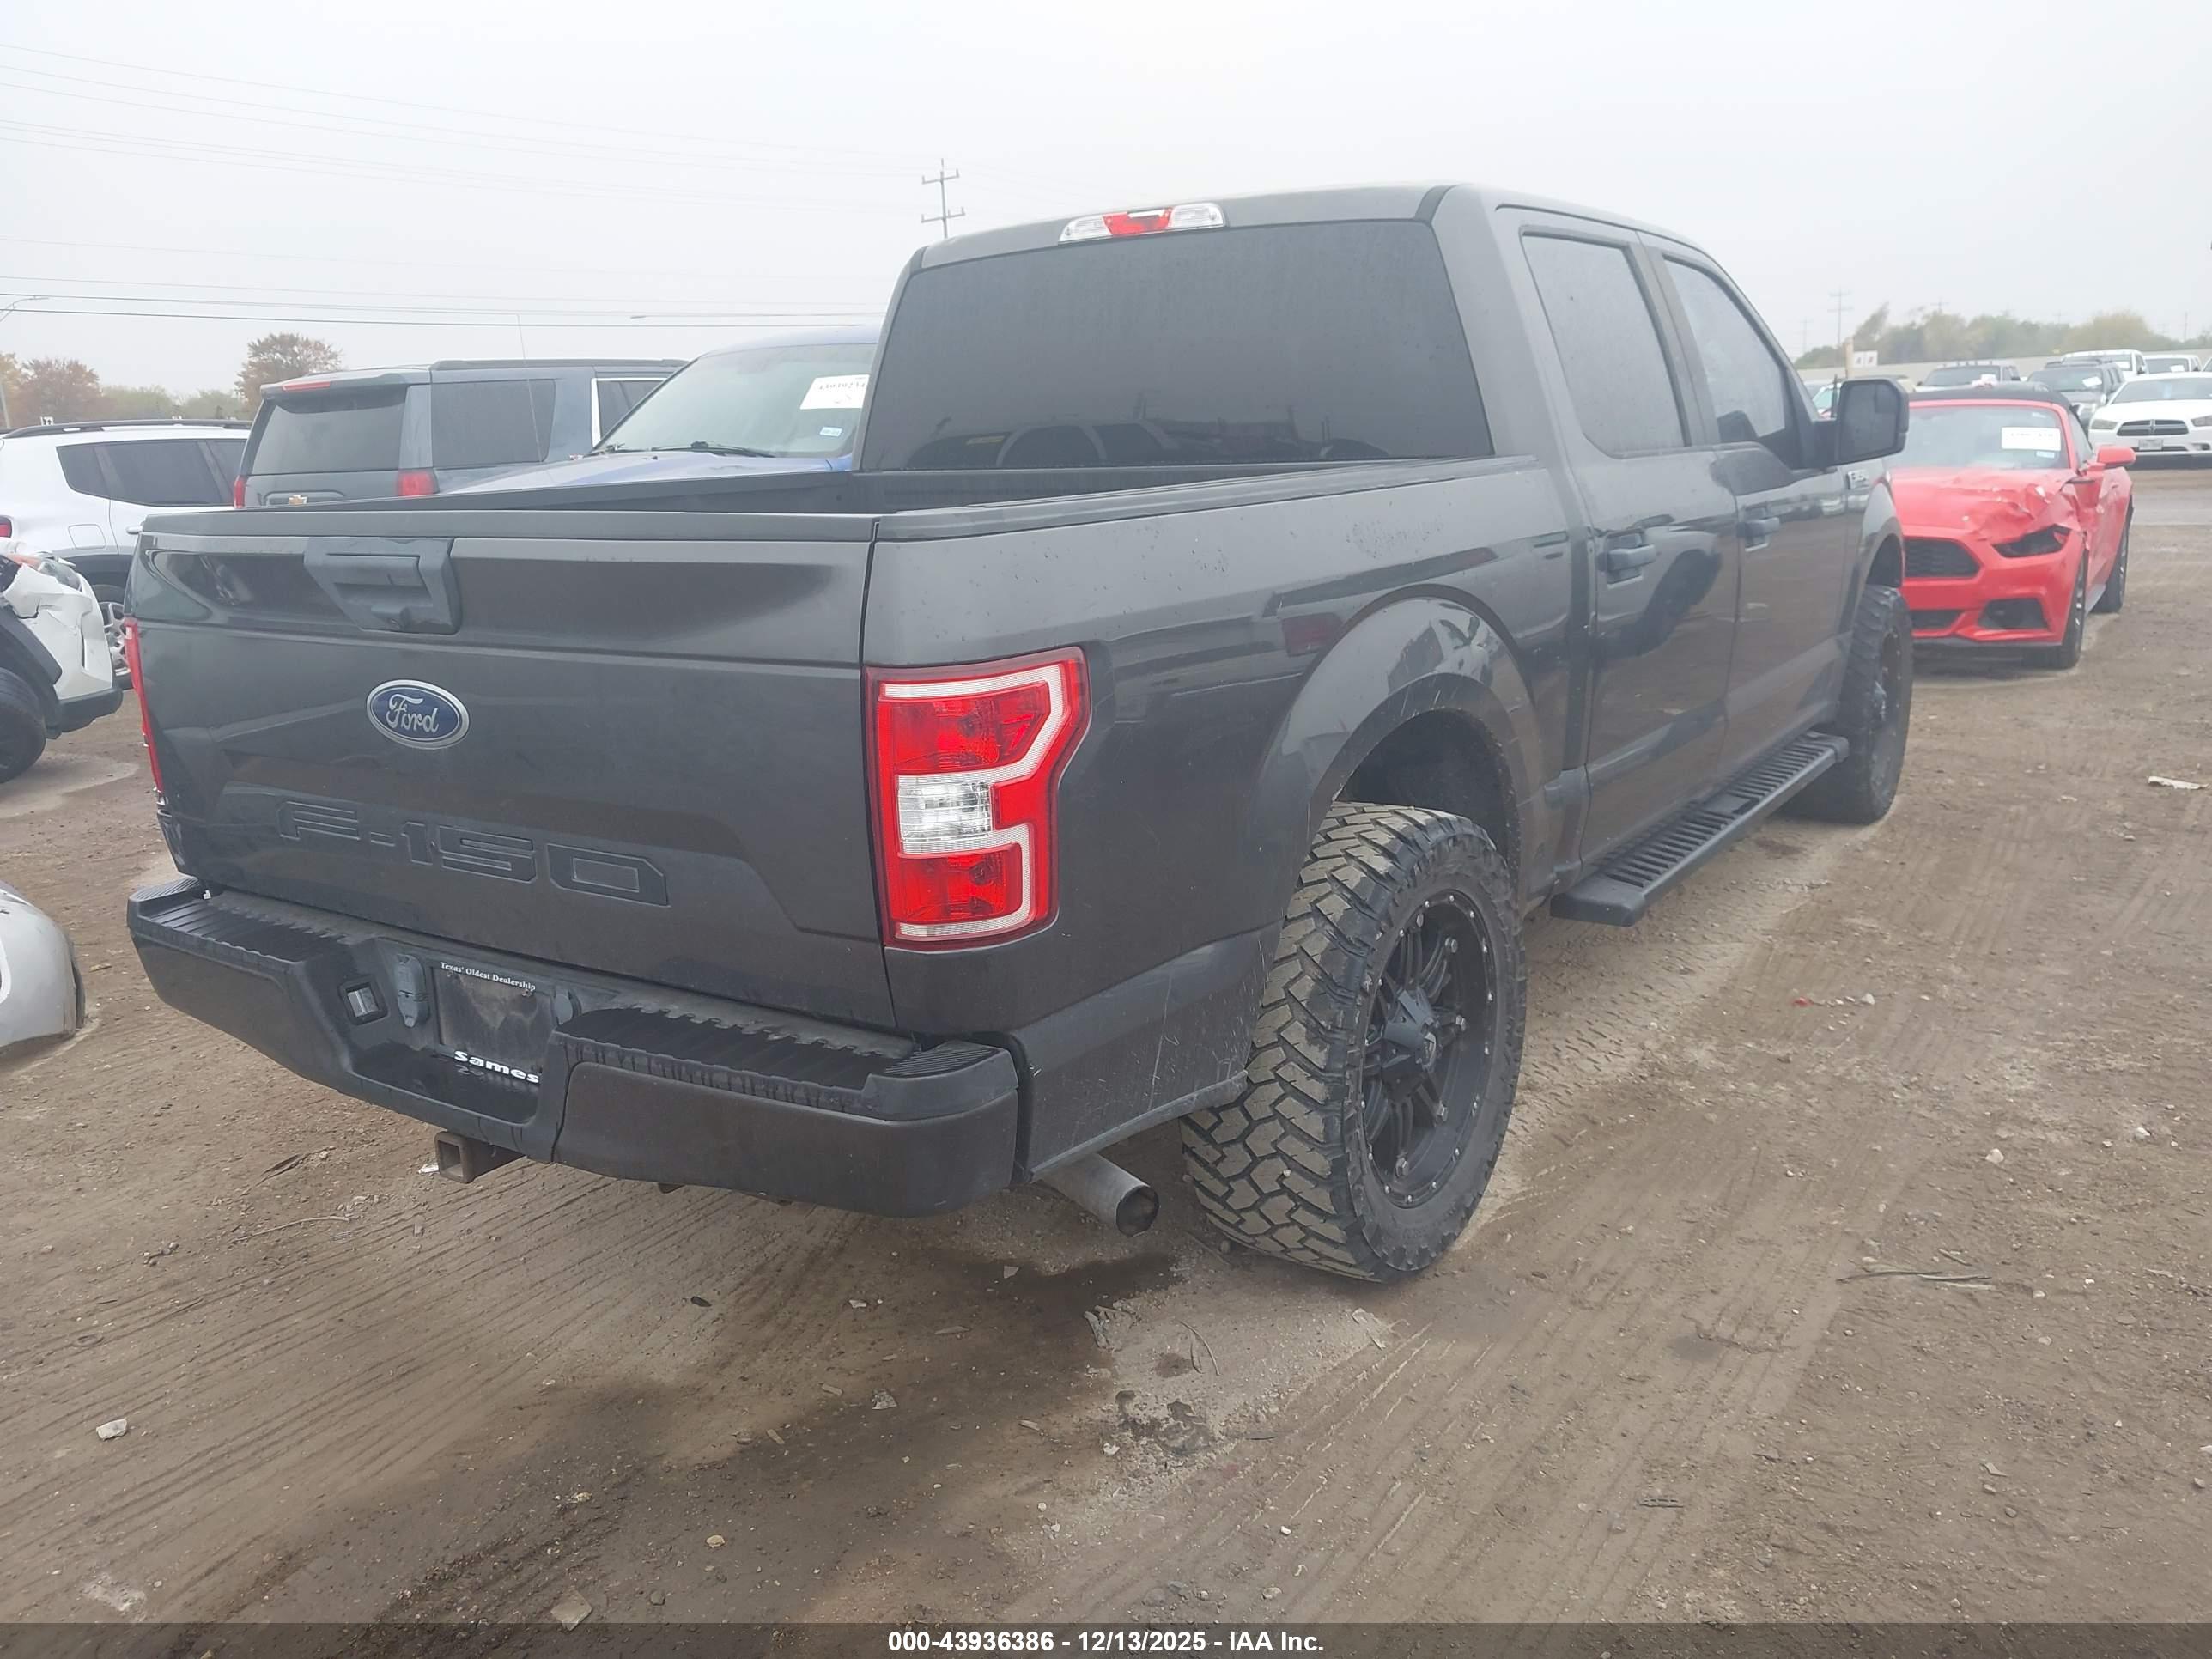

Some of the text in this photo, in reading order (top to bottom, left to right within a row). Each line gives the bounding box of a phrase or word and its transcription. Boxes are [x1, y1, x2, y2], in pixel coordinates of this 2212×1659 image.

[386, 693, 440, 734] Ford
[276, 800, 672, 908] F-150
[440, 961, 536, 992] Texas' Oldest Dealership
